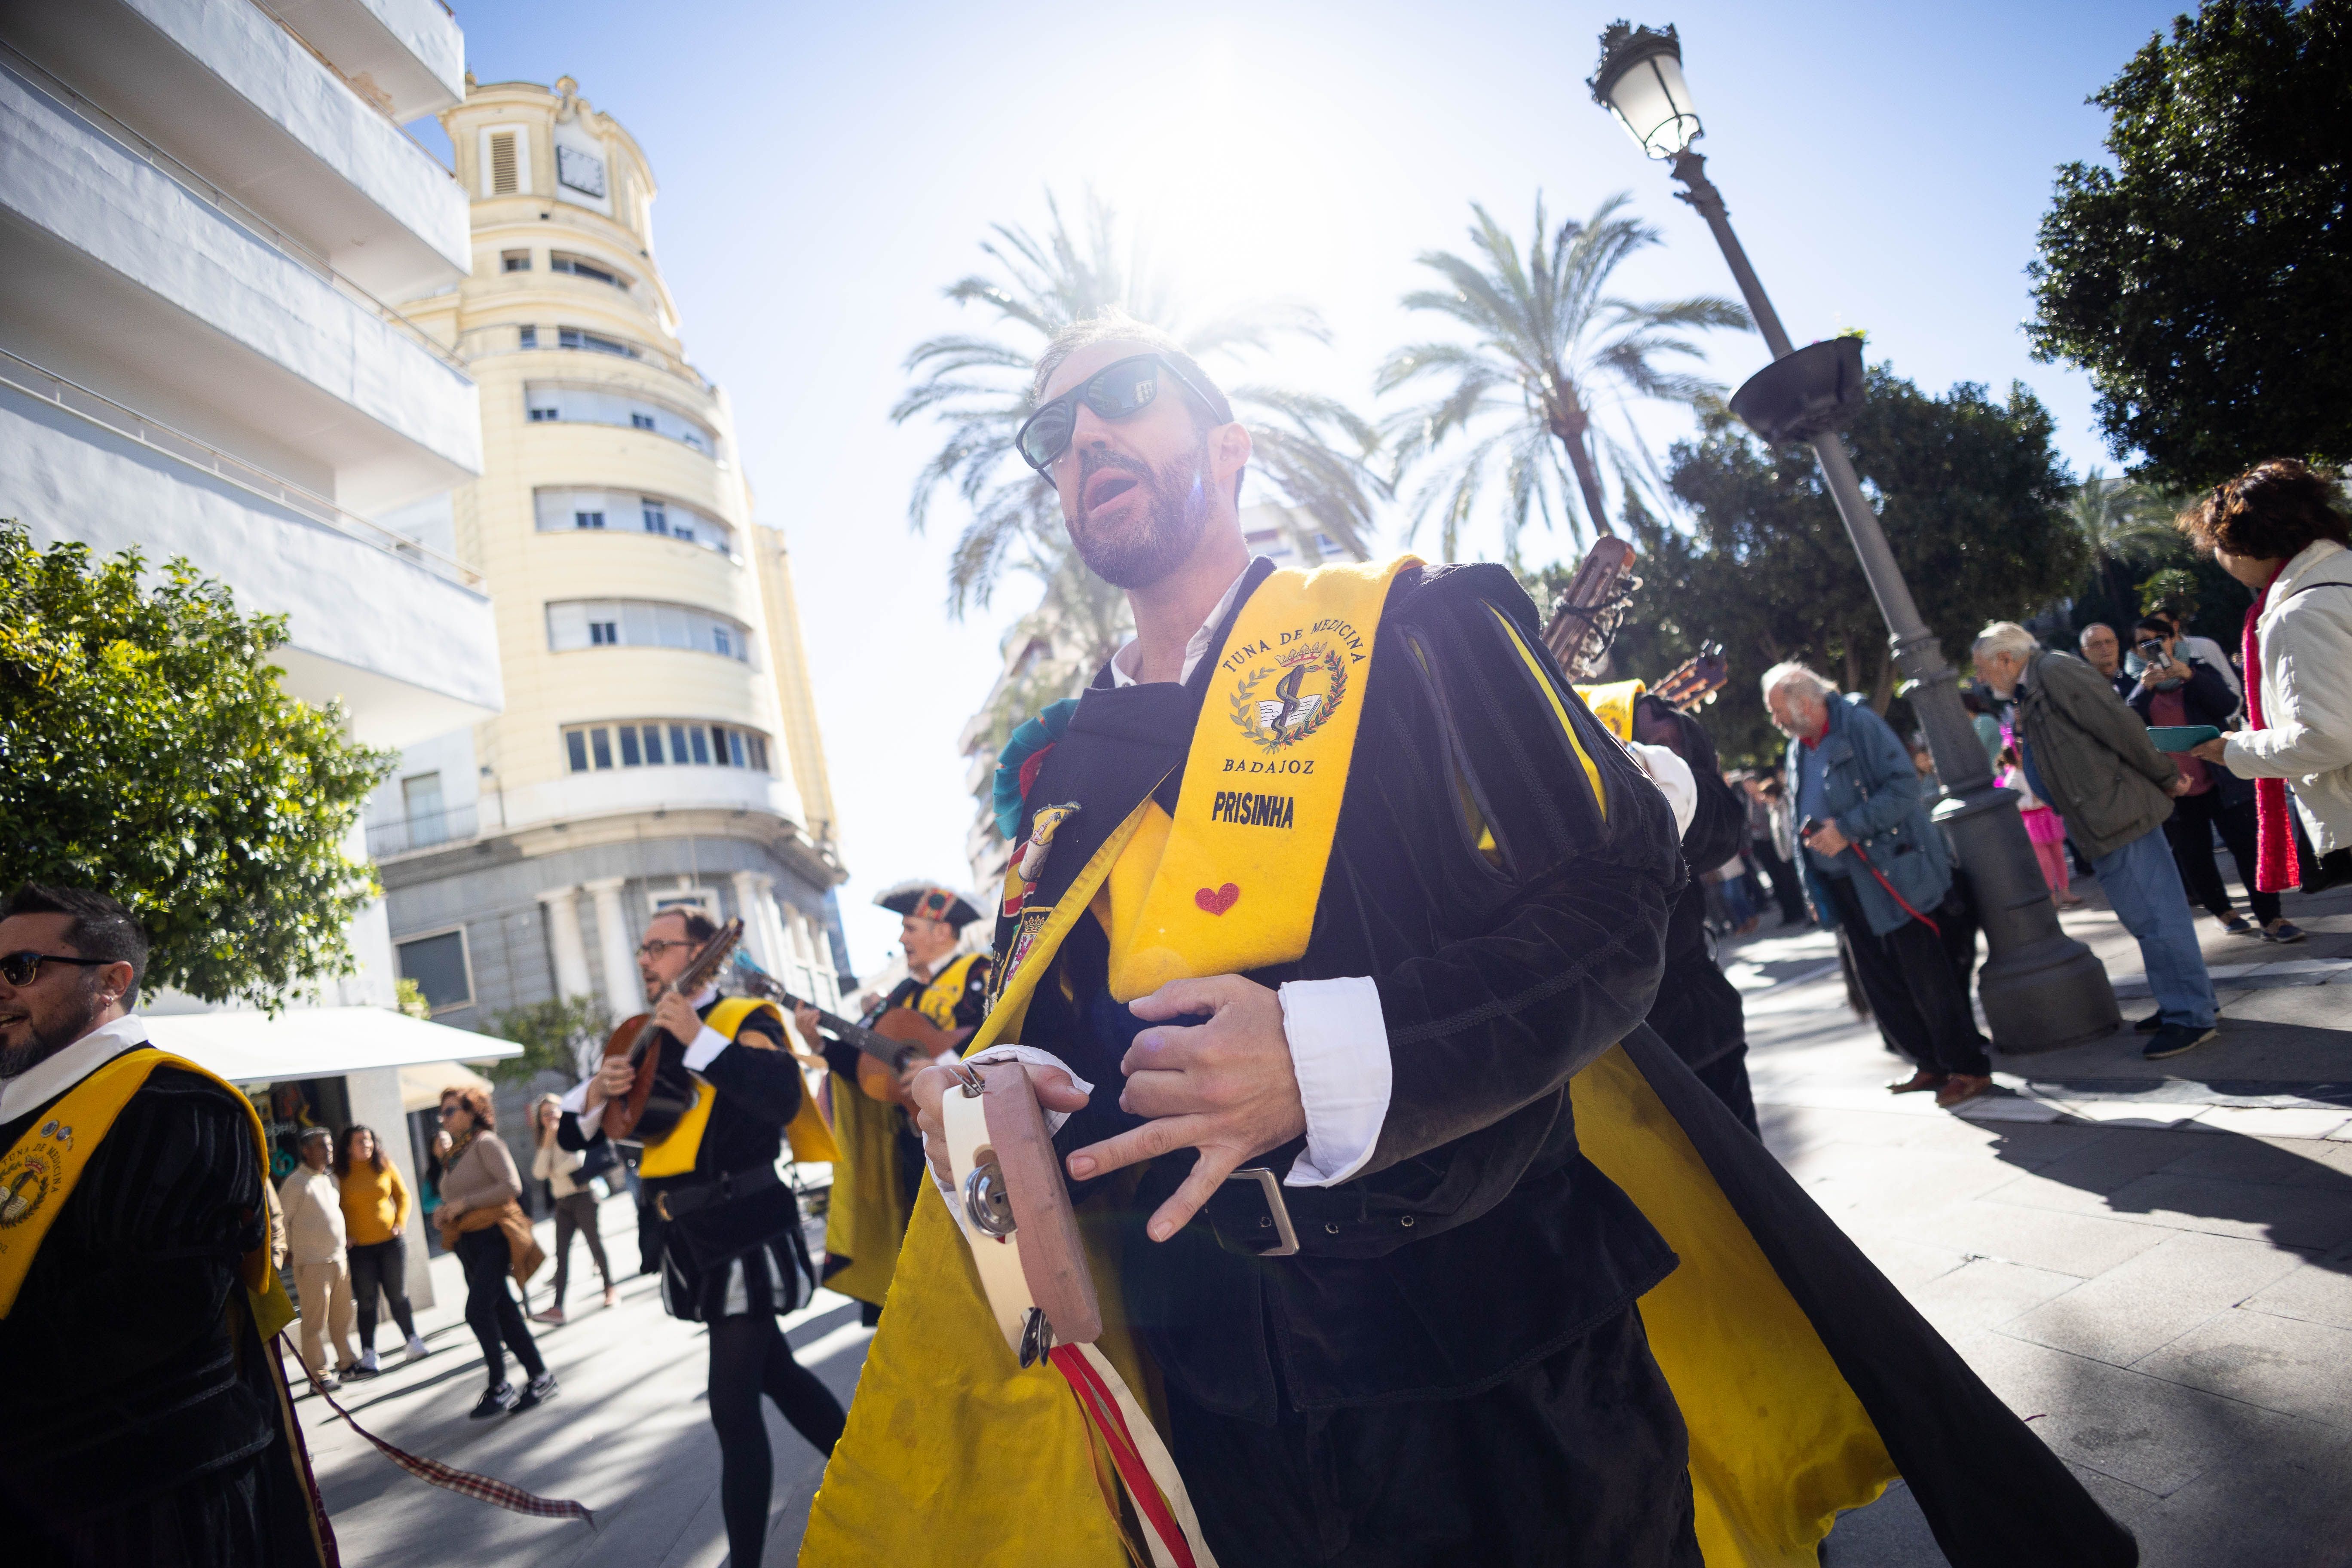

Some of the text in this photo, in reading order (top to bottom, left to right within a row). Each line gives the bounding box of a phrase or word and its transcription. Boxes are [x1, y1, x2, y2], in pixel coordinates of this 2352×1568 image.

[1222, 619, 1366, 672] TUNA DE MEDICINA
[1222, 759, 1314, 774] BADAJOZ
[1212, 792, 1293, 829] PRISINHA
[33, 1143, 46, 1152] DE
[46, 1146, 61, 1193] MEDICINA
